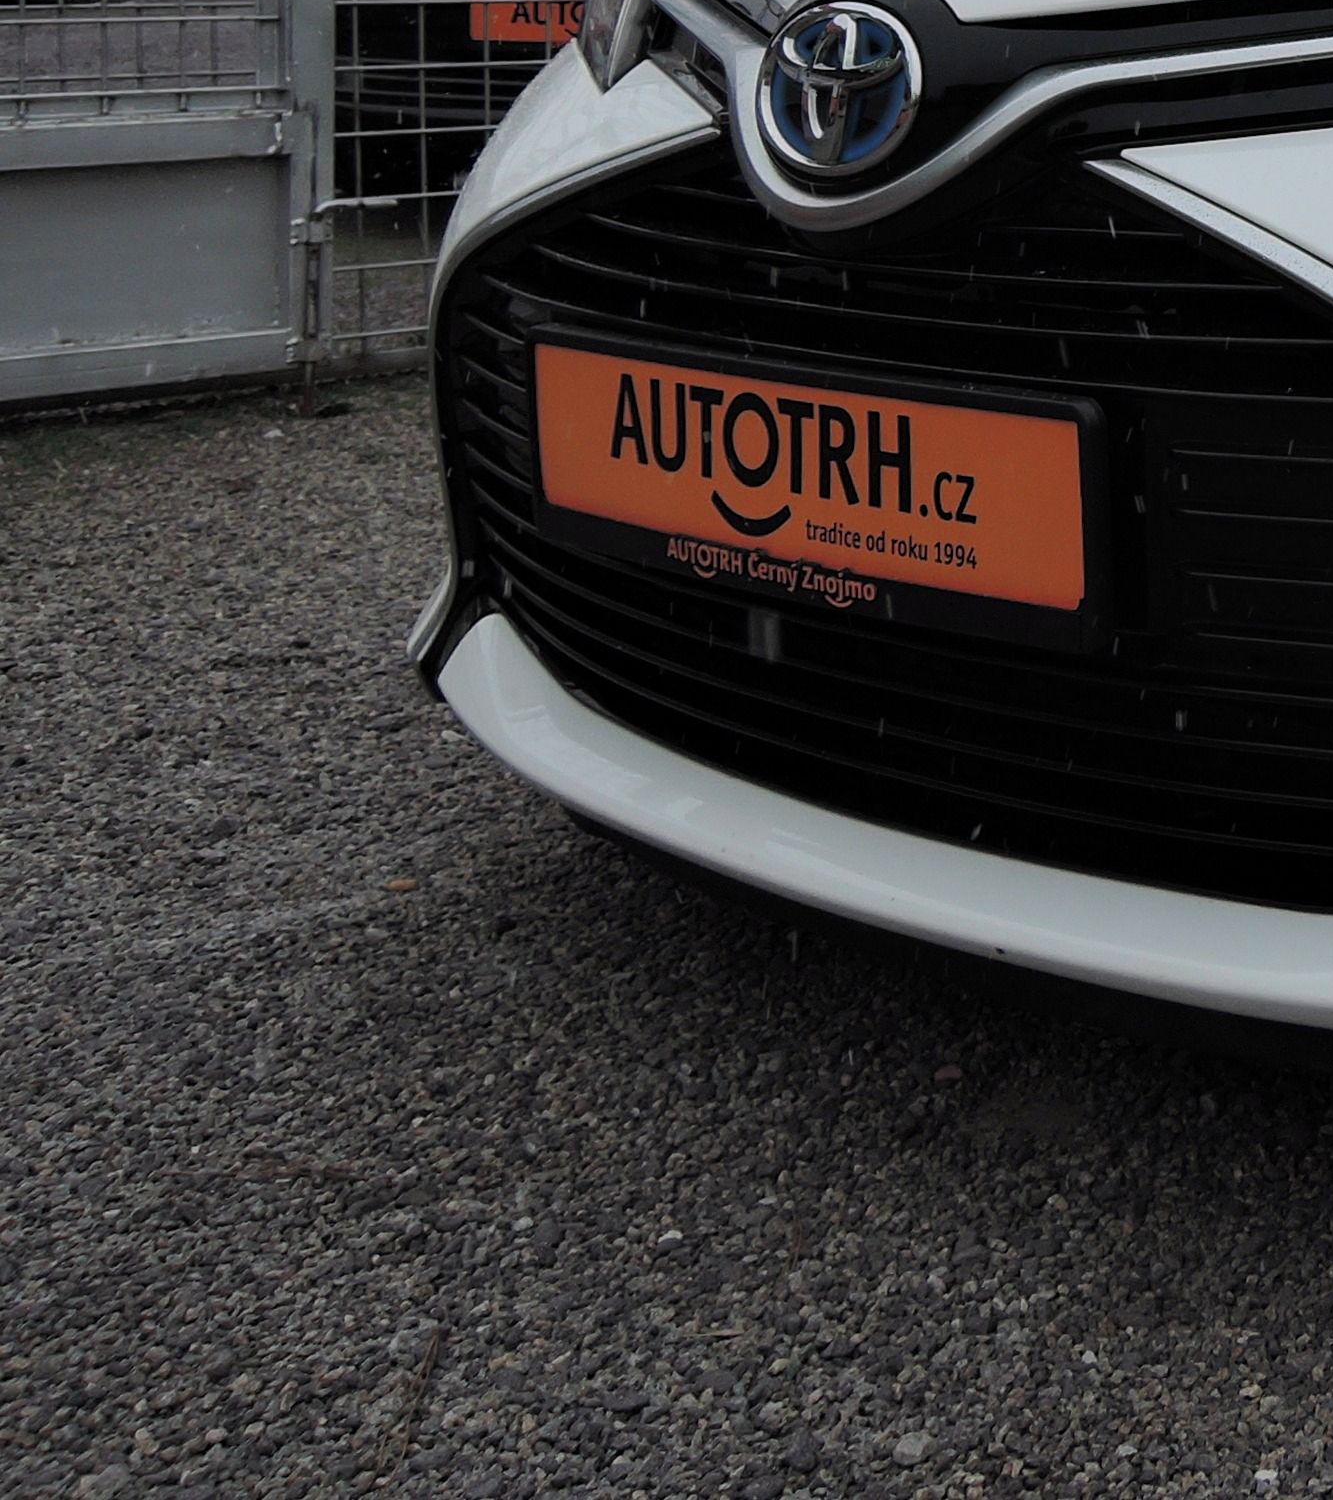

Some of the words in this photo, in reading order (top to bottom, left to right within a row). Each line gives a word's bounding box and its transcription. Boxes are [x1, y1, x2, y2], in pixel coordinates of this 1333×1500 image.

[610, 373, 978, 524] AUTOTRH.cz
[666, 537, 743, 577] AUTOTRH
[746, 552, 798, 593] Černý
[802, 566, 876, 602] Znojmo
[805, 519, 861, 550] tradice
[866, 529, 886, 554] od
[890, 533, 929, 560] roku
[933, 542, 978, 570] 1994
